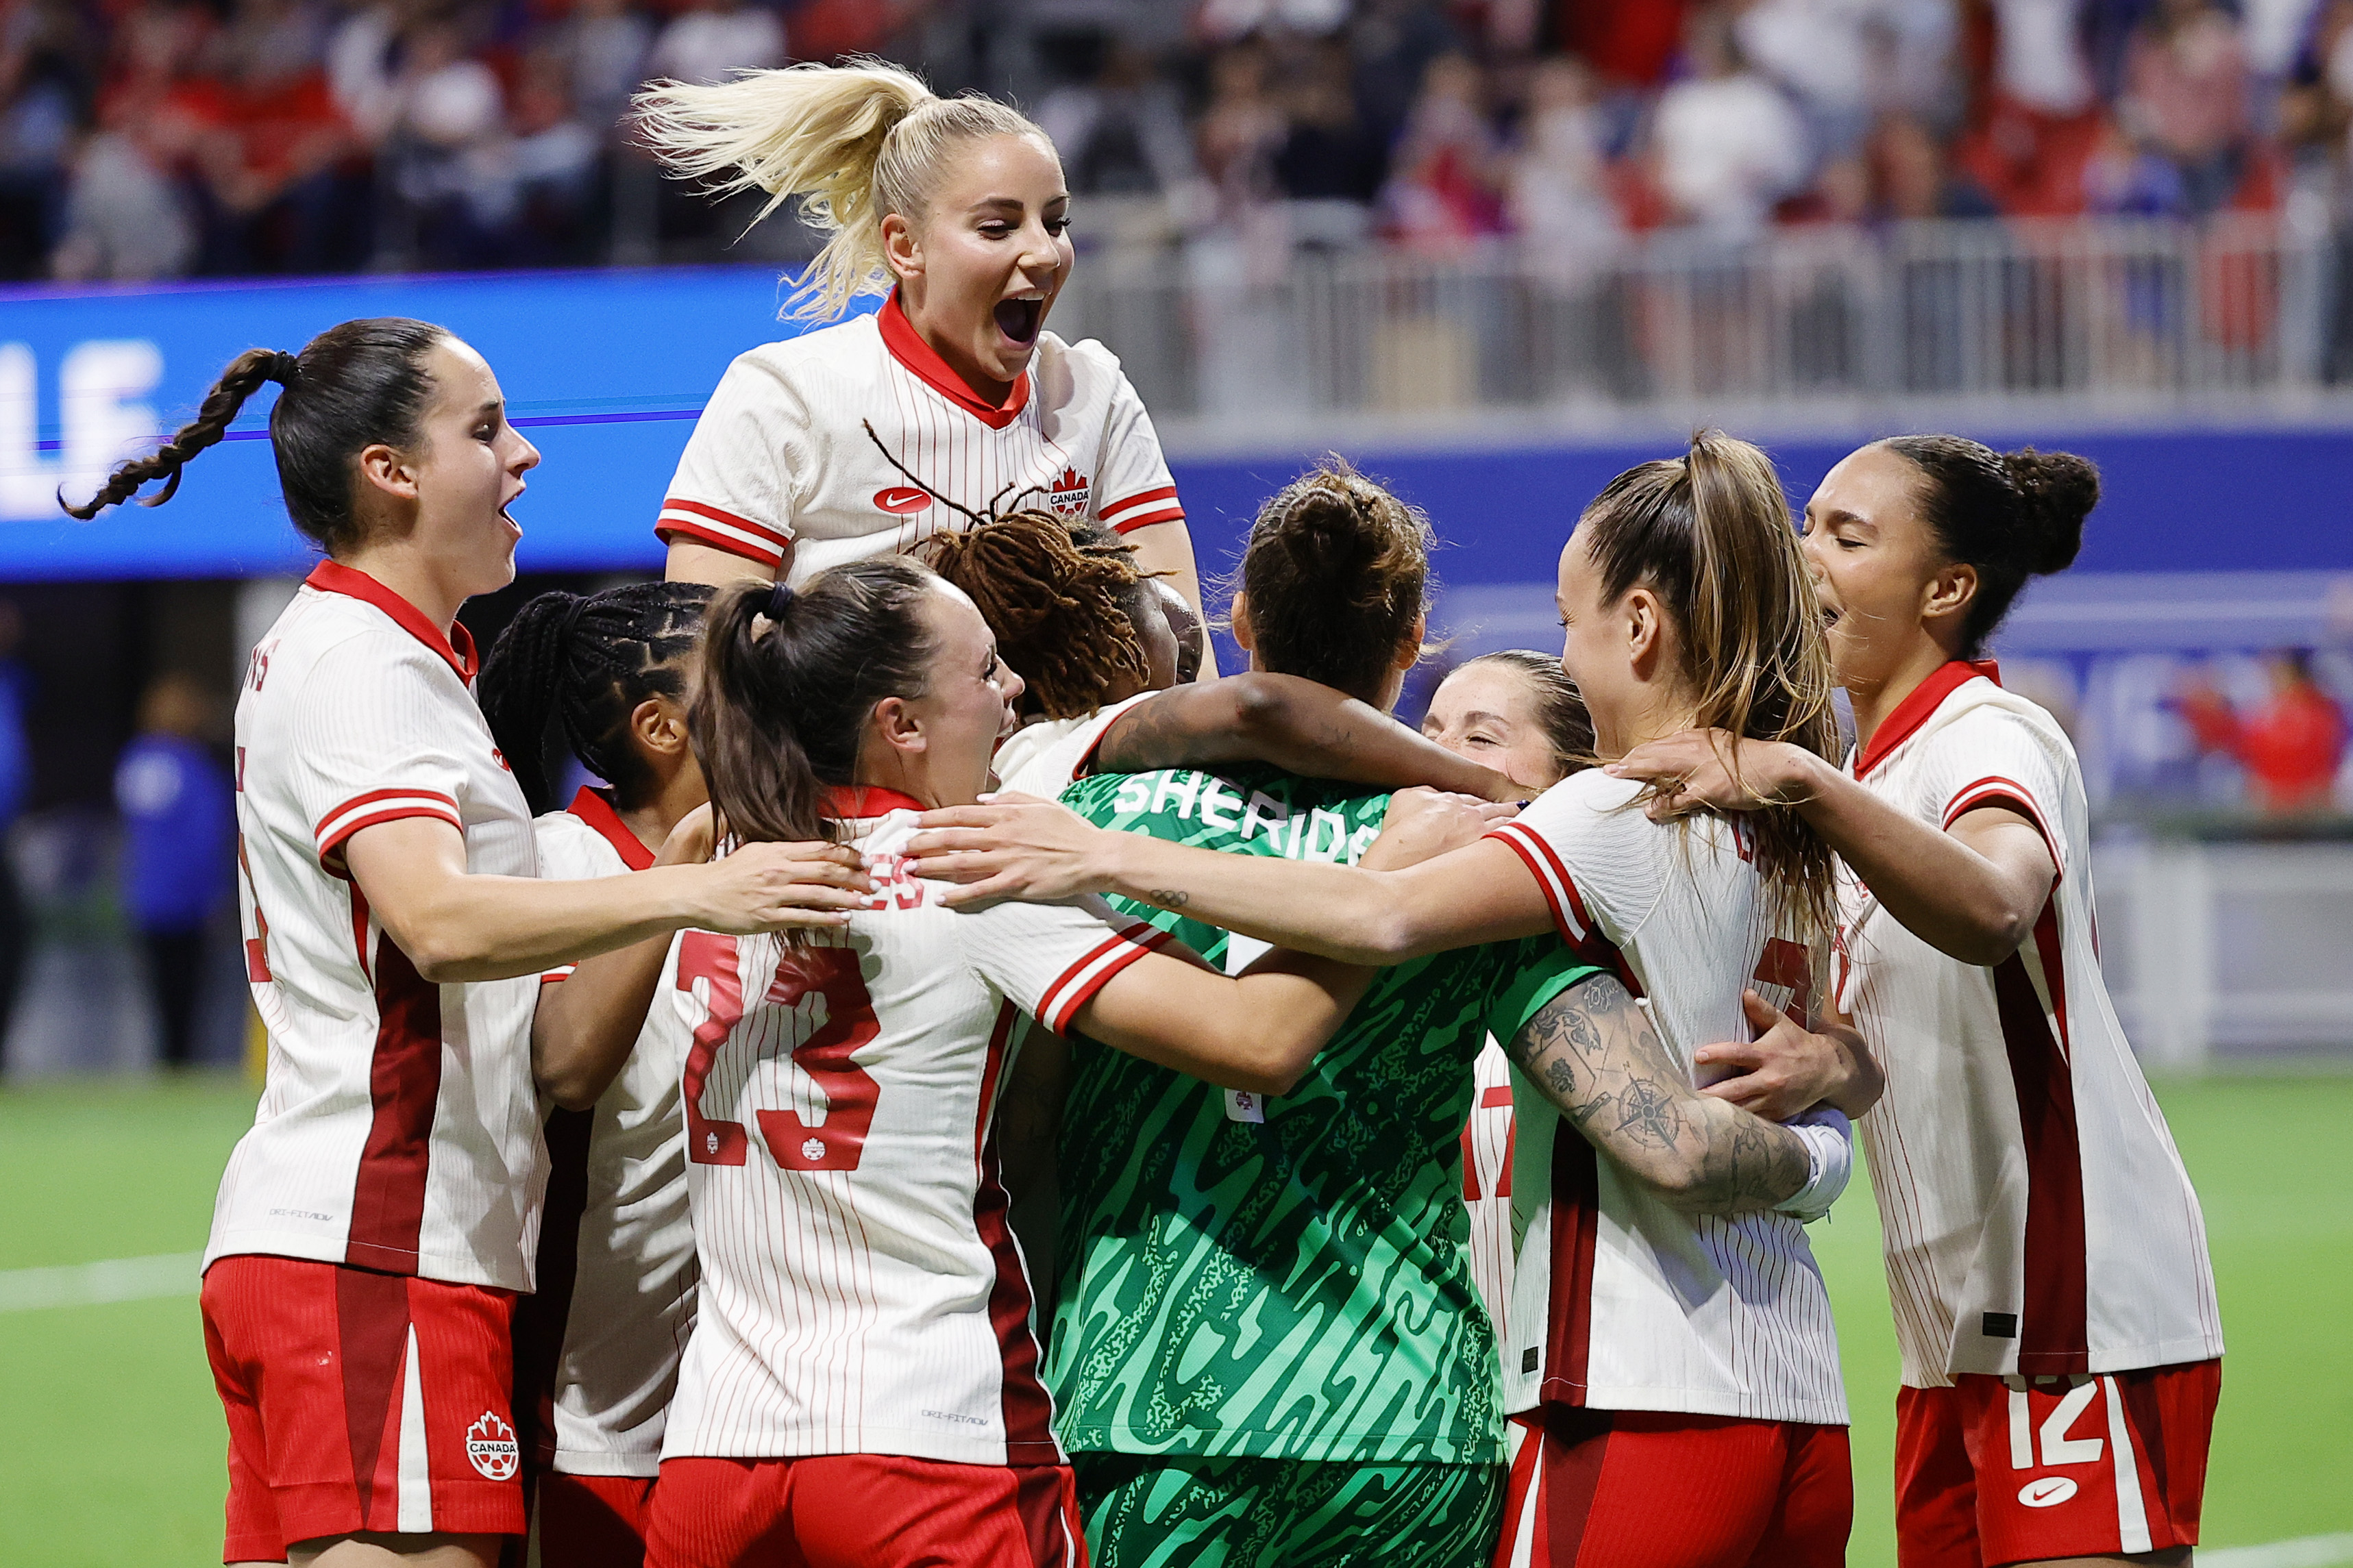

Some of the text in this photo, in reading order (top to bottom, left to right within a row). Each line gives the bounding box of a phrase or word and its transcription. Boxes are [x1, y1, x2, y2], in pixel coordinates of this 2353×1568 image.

[1050, 490, 1089, 505] CANADA
[1113, 769, 1381, 867] SHERIDA
[676, 930, 881, 1171] 23
[470, 1443, 516, 1453] CANADA
[2004, 1374, 2104, 1470] 12
